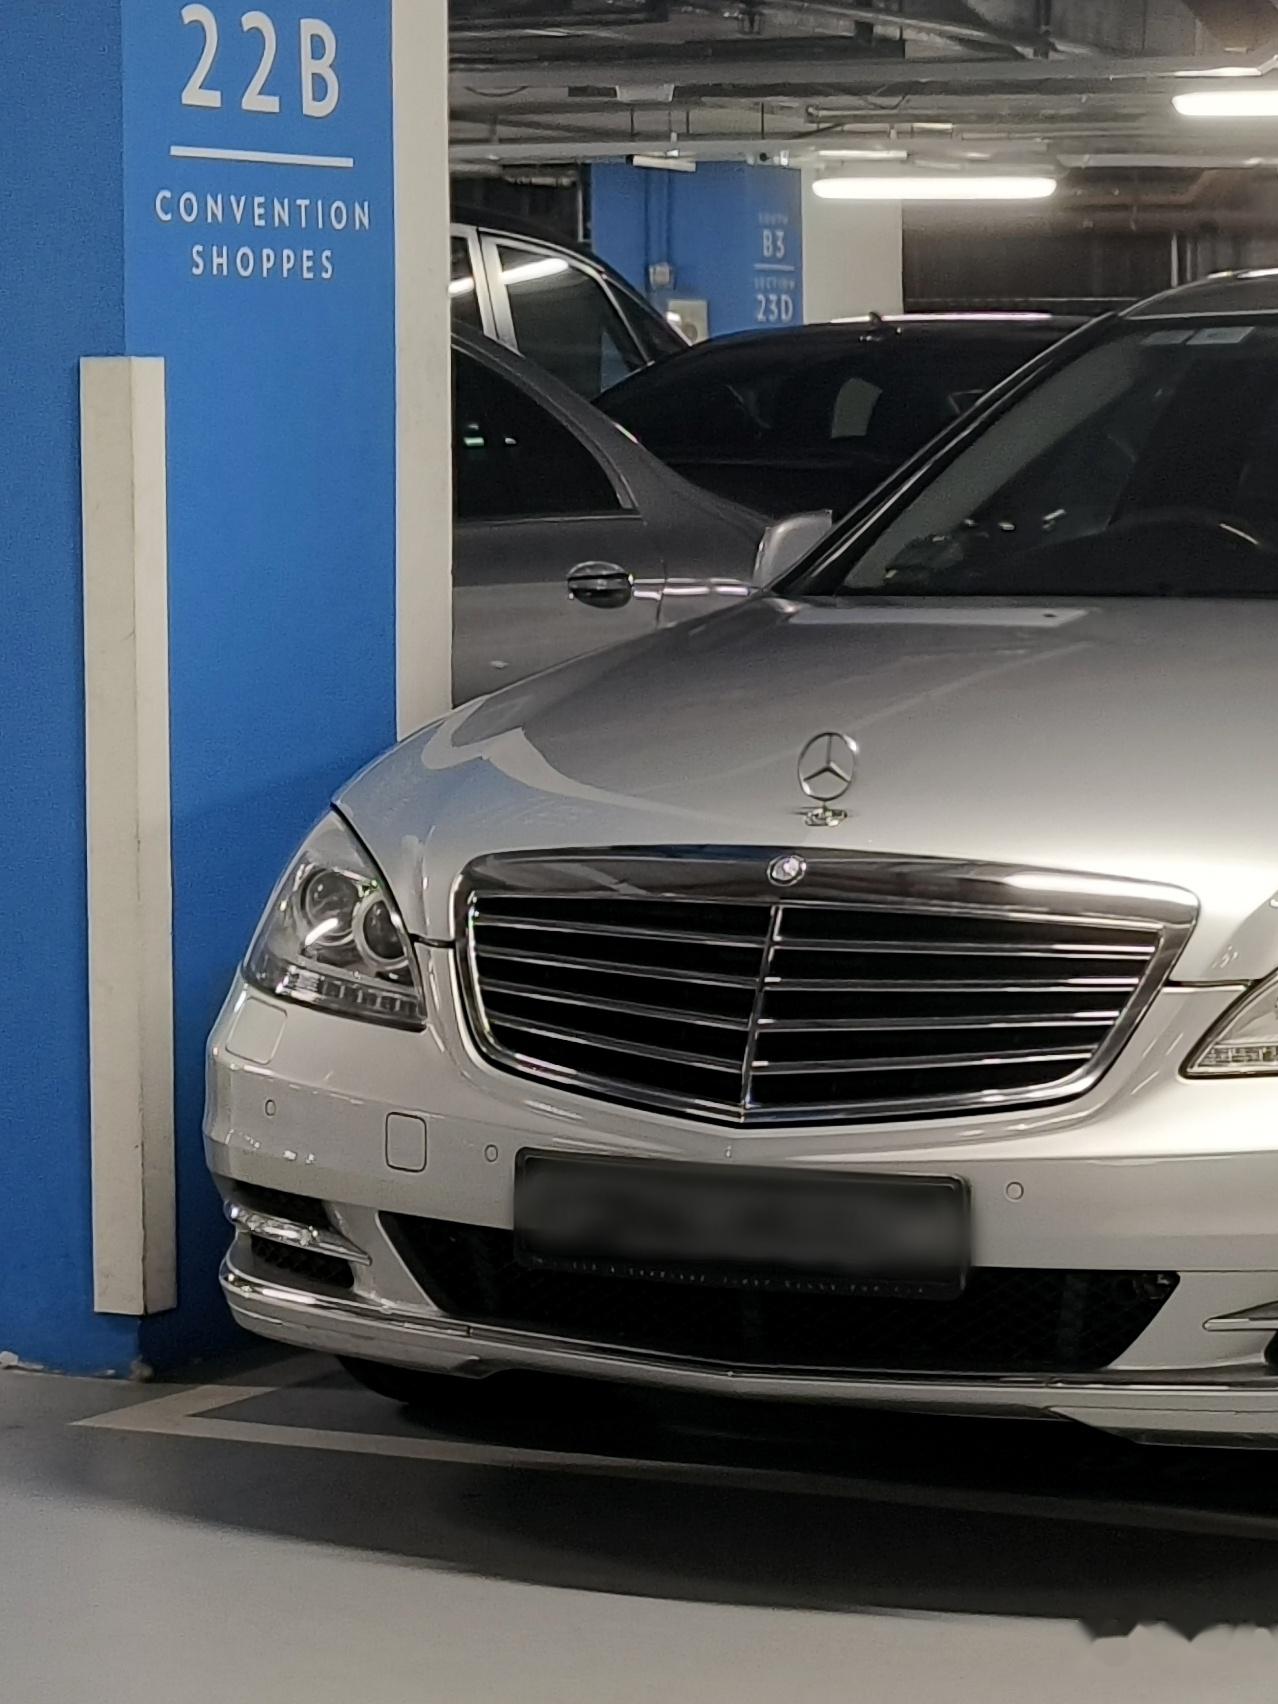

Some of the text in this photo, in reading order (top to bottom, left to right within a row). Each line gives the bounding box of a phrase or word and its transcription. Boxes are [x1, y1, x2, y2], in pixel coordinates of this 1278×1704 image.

[180, 3, 340, 118] 22B
[154, 189, 370, 230] CONVENTION
[762, 228, 785, 259] B3
[191, 244, 334, 279] SHOPPES
[756, 293, 794, 323] 23D
